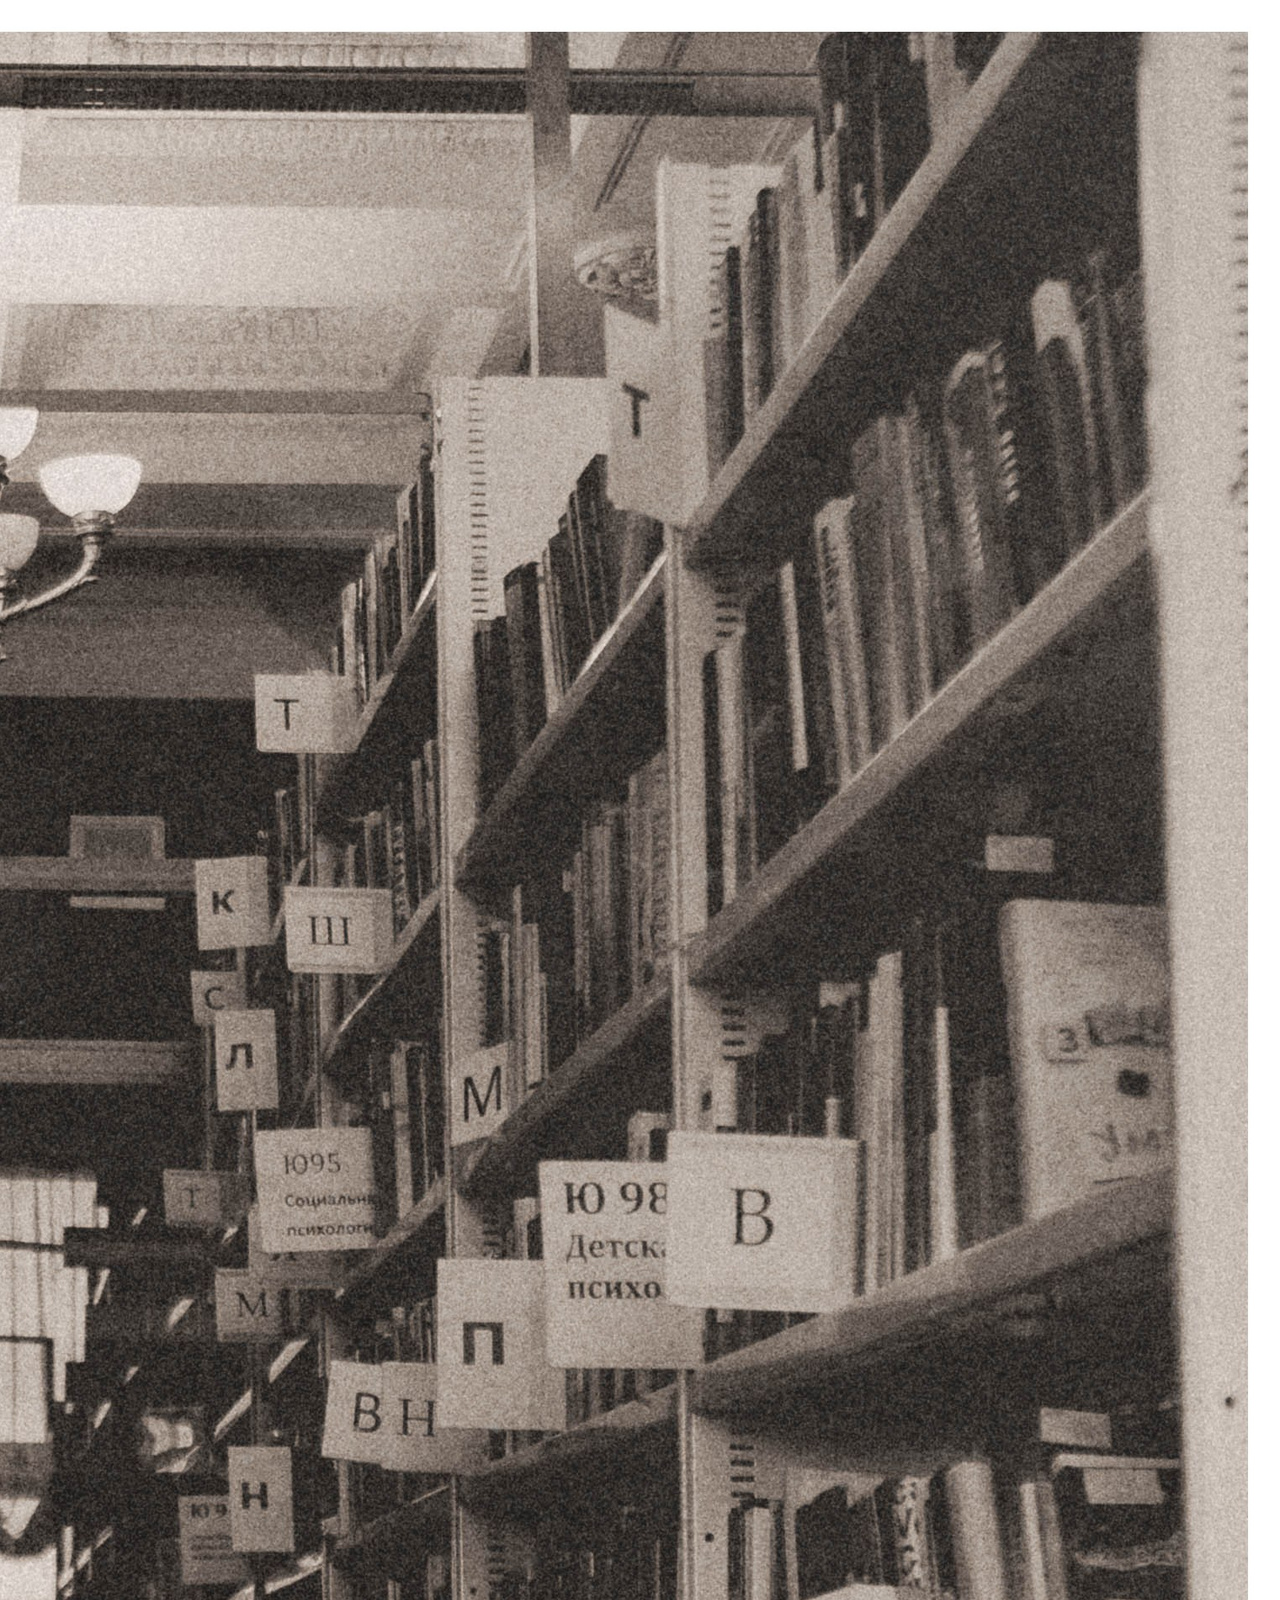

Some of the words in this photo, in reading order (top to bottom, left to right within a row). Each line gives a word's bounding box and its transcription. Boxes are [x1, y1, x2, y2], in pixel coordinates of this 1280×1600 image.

[621, 383, 650, 438] Т
[273, 698, 300, 731] Т
[212, 889, 235, 915] К
[308, 914, 351, 947] Ш
[203, 985, 224, 1011] С
[225, 1042, 254, 1071] Л
[462, 1066, 503, 1122] М
[283, 1152, 342, 1176] Ю95
[565, 1180, 606, 1216] Ю
[730, 1186, 776, 1247] В
[566, 1233, 667, 1263] Детск
[236, 1291, 269, 1318] М
[568, 1278, 663, 1301] психо
[462, 1321, 505, 1366] П
[352, 1391, 383, 1434] В
[401, 1398, 436, 1437] Н
[241, 1481, 269, 1510] Н
